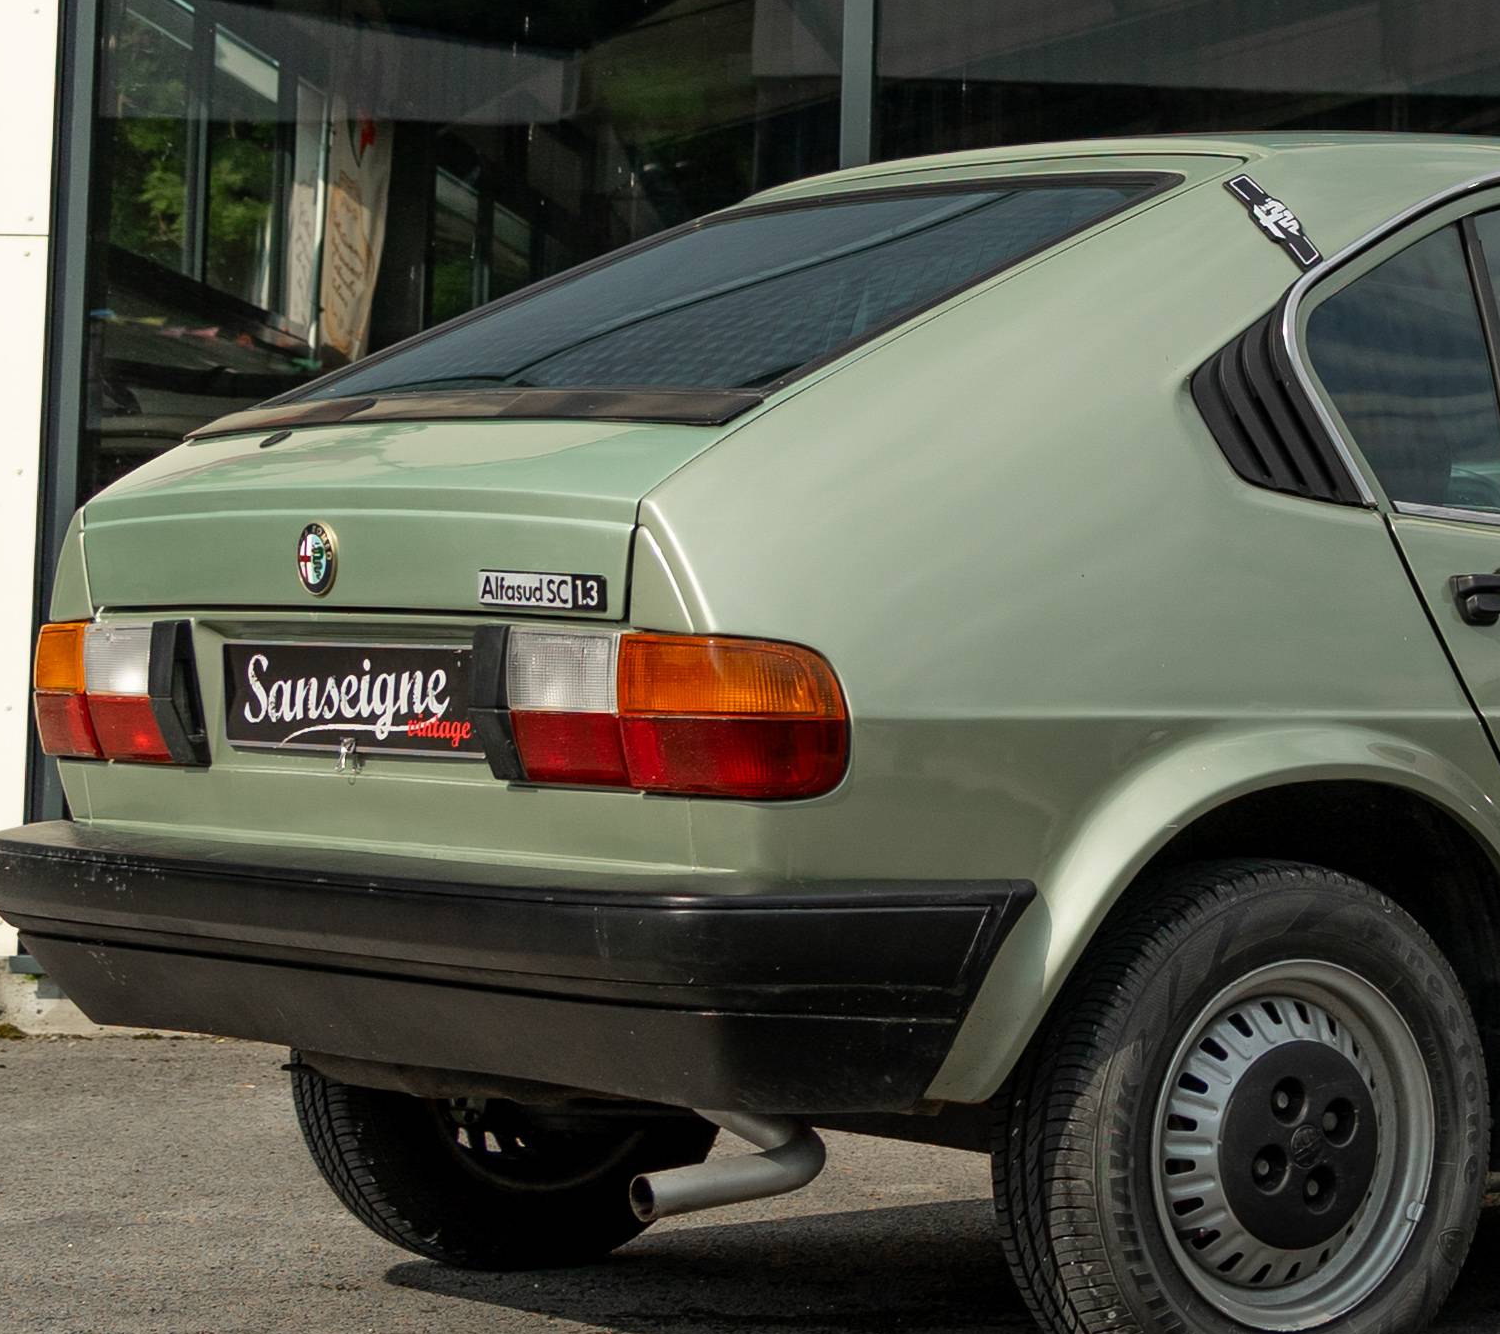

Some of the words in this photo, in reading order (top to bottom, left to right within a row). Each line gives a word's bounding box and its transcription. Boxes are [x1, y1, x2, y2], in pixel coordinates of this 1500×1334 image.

[480, 575, 544, 602] Alfasud
[546, 578, 569, 605] SC
[575, 579, 599, 606] 1.3
[244, 653, 450, 740] Sanseigne
[407, 714, 473, 747] vintage
